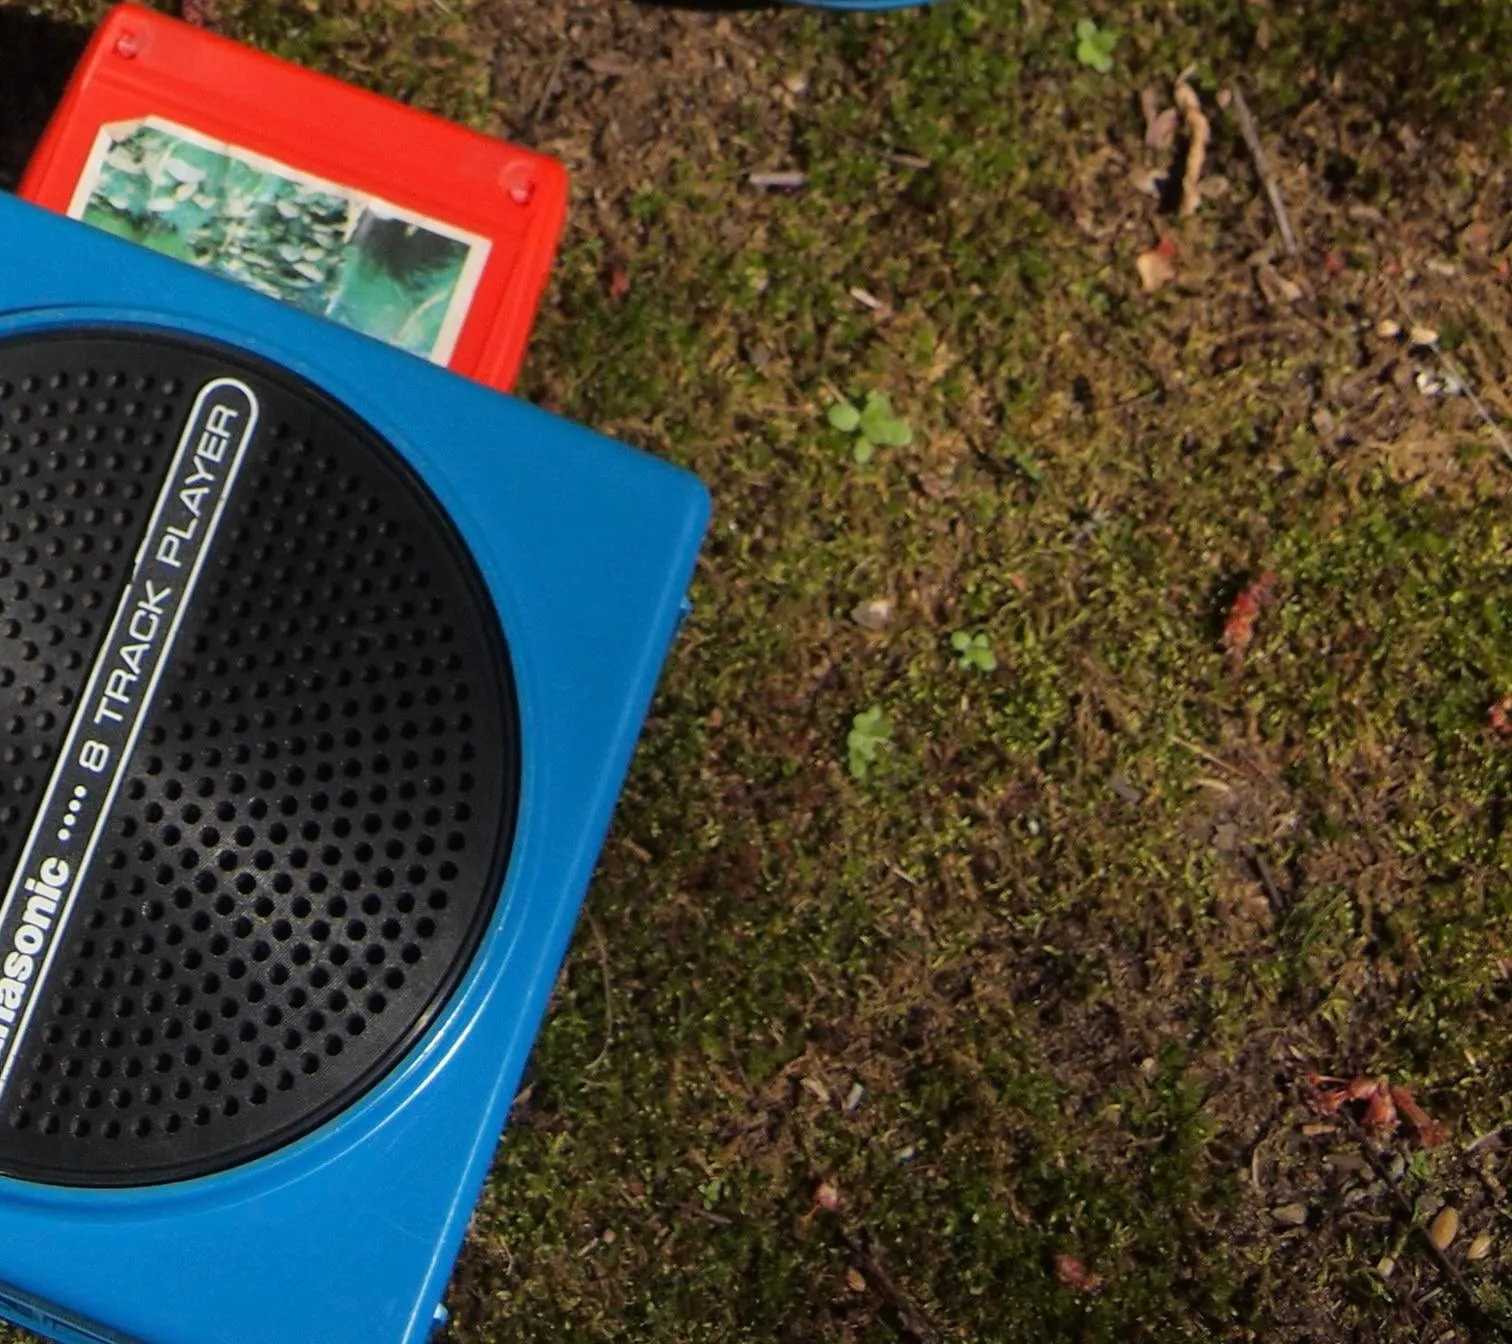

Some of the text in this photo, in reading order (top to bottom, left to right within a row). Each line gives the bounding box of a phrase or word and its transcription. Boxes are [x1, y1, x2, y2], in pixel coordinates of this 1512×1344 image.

[78, 740, 110, 775] 8
[94, 579, 174, 727] TRACK
[155, 403, 239, 569] PLAYER
